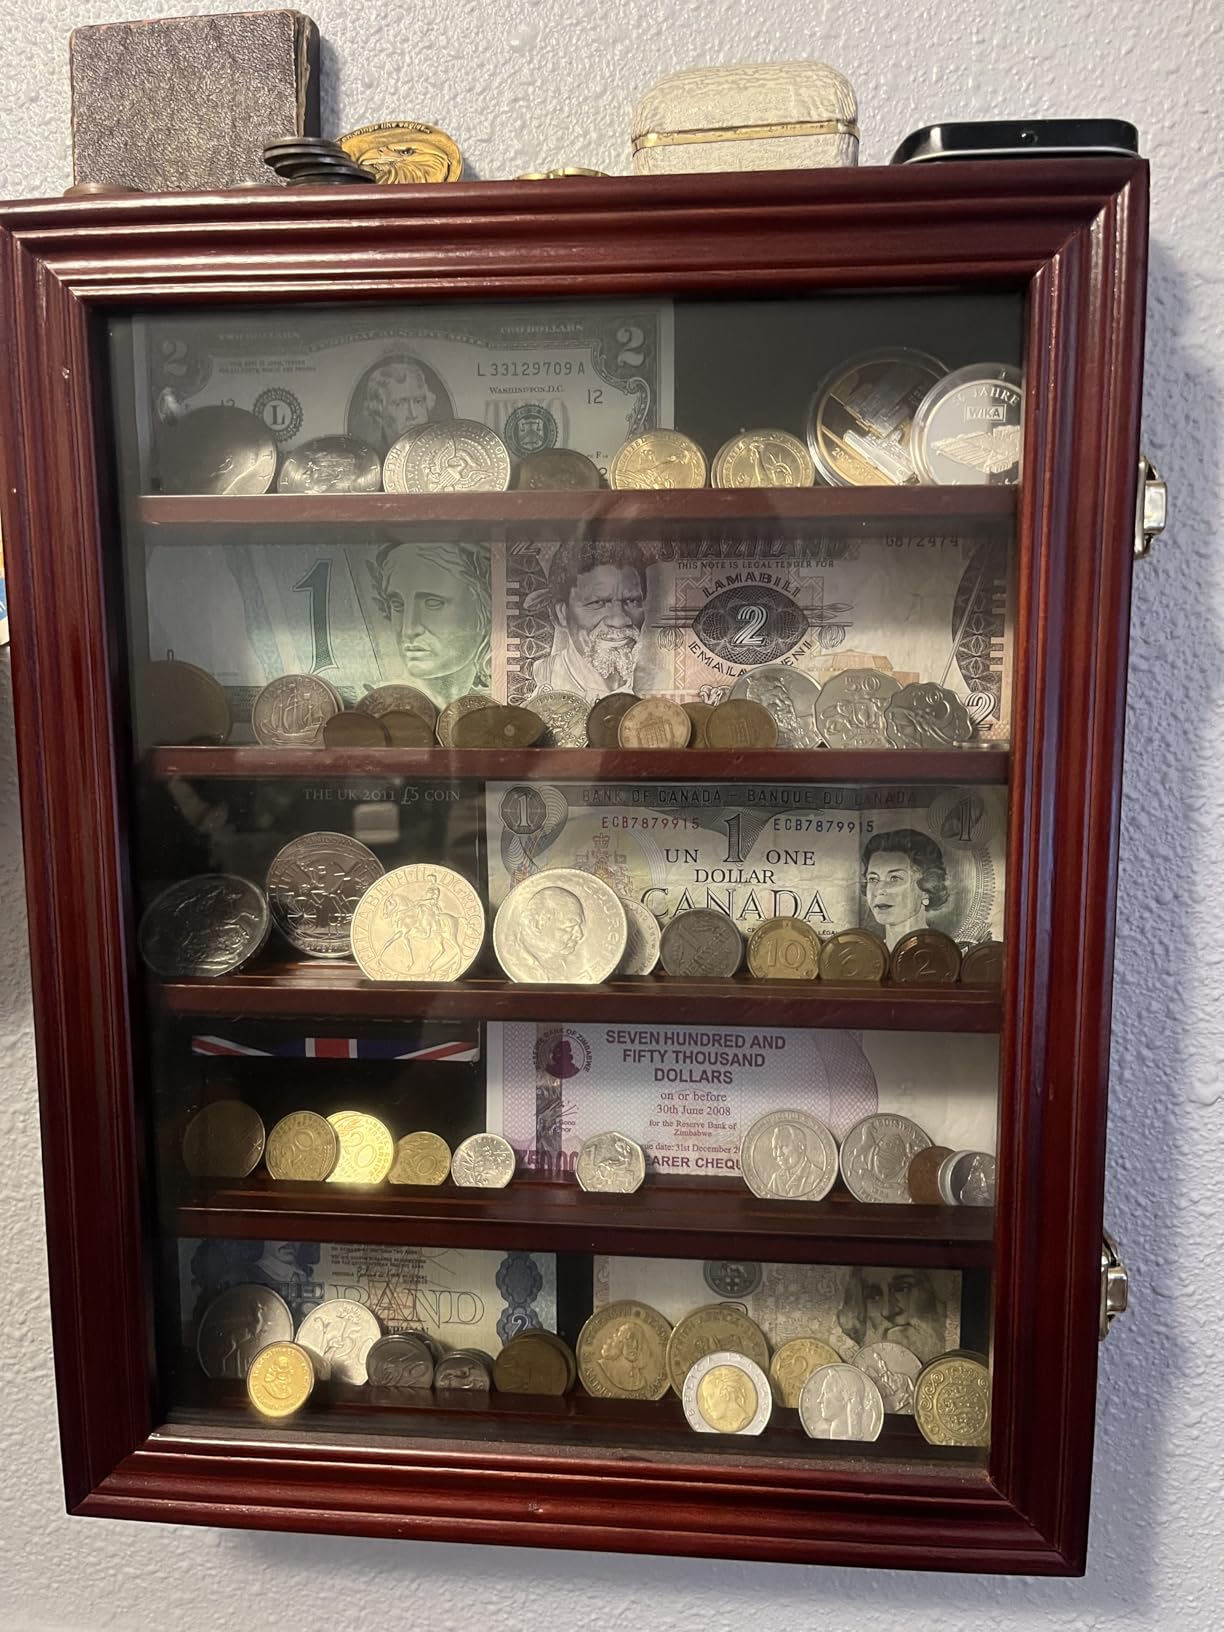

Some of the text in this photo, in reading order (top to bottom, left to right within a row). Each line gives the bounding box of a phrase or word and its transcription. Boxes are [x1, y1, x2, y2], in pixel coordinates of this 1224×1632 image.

[616, 326, 645, 367] 2
[587, 388, 604, 405] 12
[270, 404, 287, 426] L
[968, 407, 1001, 419] WIKA
[678, 560, 835, 570] THIS NOTE IS LEGAL TENDER FOR
[290, 557, 340, 675] 1
[730, 604, 770, 646] 2
[843, 674, 881, 693] 50
[965, 691, 997, 731] 2
[303, 786, 461, 805] THE UK 2011 £5 COIN
[583, 789, 622, 802] BANK
[631, 790, 650, 803] OF
[659, 790, 722, 803] CANADA
[746, 789, 811, 804] BANQUE
[822, 791, 843, 805] DU
[517, 794, 532, 829] 1
[957, 797, 973, 842] 1
[601, 816, 700, 830] ECB7879915
[773, 818, 875, 834] ECB7879915
[723, 813, 745, 864] 1
[664, 848, 816, 866] UN ONE
[694, 869, 776, 885] DOLLAR
[640, 886, 834, 924] CANADA
[767, 939, 806, 969] 10
[913, 948, 937, 975] 2
[605, 1029, 786, 1050] SEVEN HUNDRED AND
[622, 1048, 766, 1068] FIFTY THOUSAND
[654, 1067, 734, 1085] DOLLARS
[660, 1091, 727, 1102] on or before
[656, 1104, 732, 1116] 30th June 2008
[649, 1119, 661, 1127] for
[676, 1120, 705, 1129] Reserve
[707, 1121, 727, 1130] Bank
[728, 1122, 738, 1130] of
[673, 1128, 713, 1138] Zimbabwe
[676, 1144, 690, 1152] 31st
[692, 1144, 732, 1154] December
[645, 1156, 742, 1171] EARER CHEQU
[329, 1280, 485, 1329] RAND
[511, 1313, 529, 1338] 2
